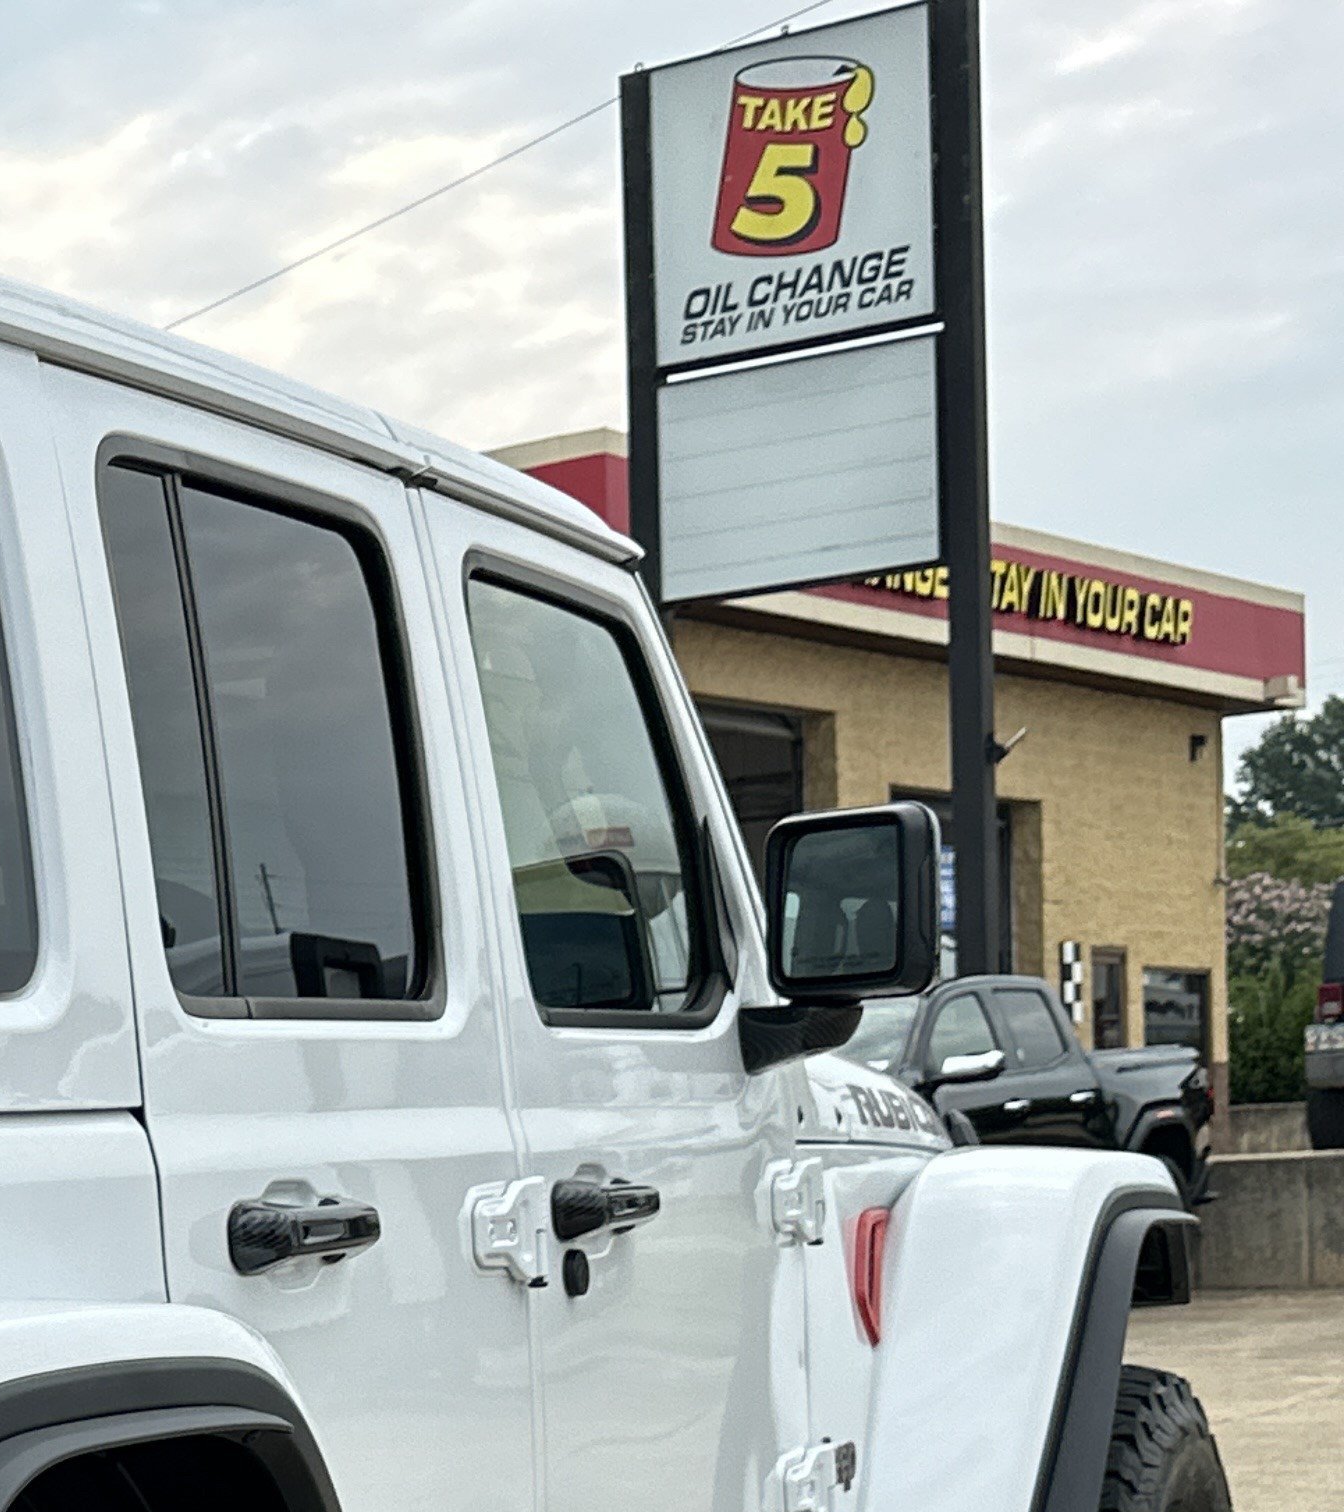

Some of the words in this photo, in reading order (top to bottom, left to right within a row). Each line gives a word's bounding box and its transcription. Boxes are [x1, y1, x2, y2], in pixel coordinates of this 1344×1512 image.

[737, 92, 837, 133] TAKE
[730, 143, 819, 244] 5
[680, 315, 742, 346] STAY
[745, 307, 775, 333] IN
[782, 292, 853, 326] YOUR
[858, 278, 915, 311] CAR
[683, 282, 740, 321] OIL
[746, 246, 911, 308] CHANGE
[990, 559, 1035, 613] TAY
[1039, 570, 1068, 621] IN
[1075, 577, 1141, 634] YOUR
[1143, 592, 1194, 644] CAR
